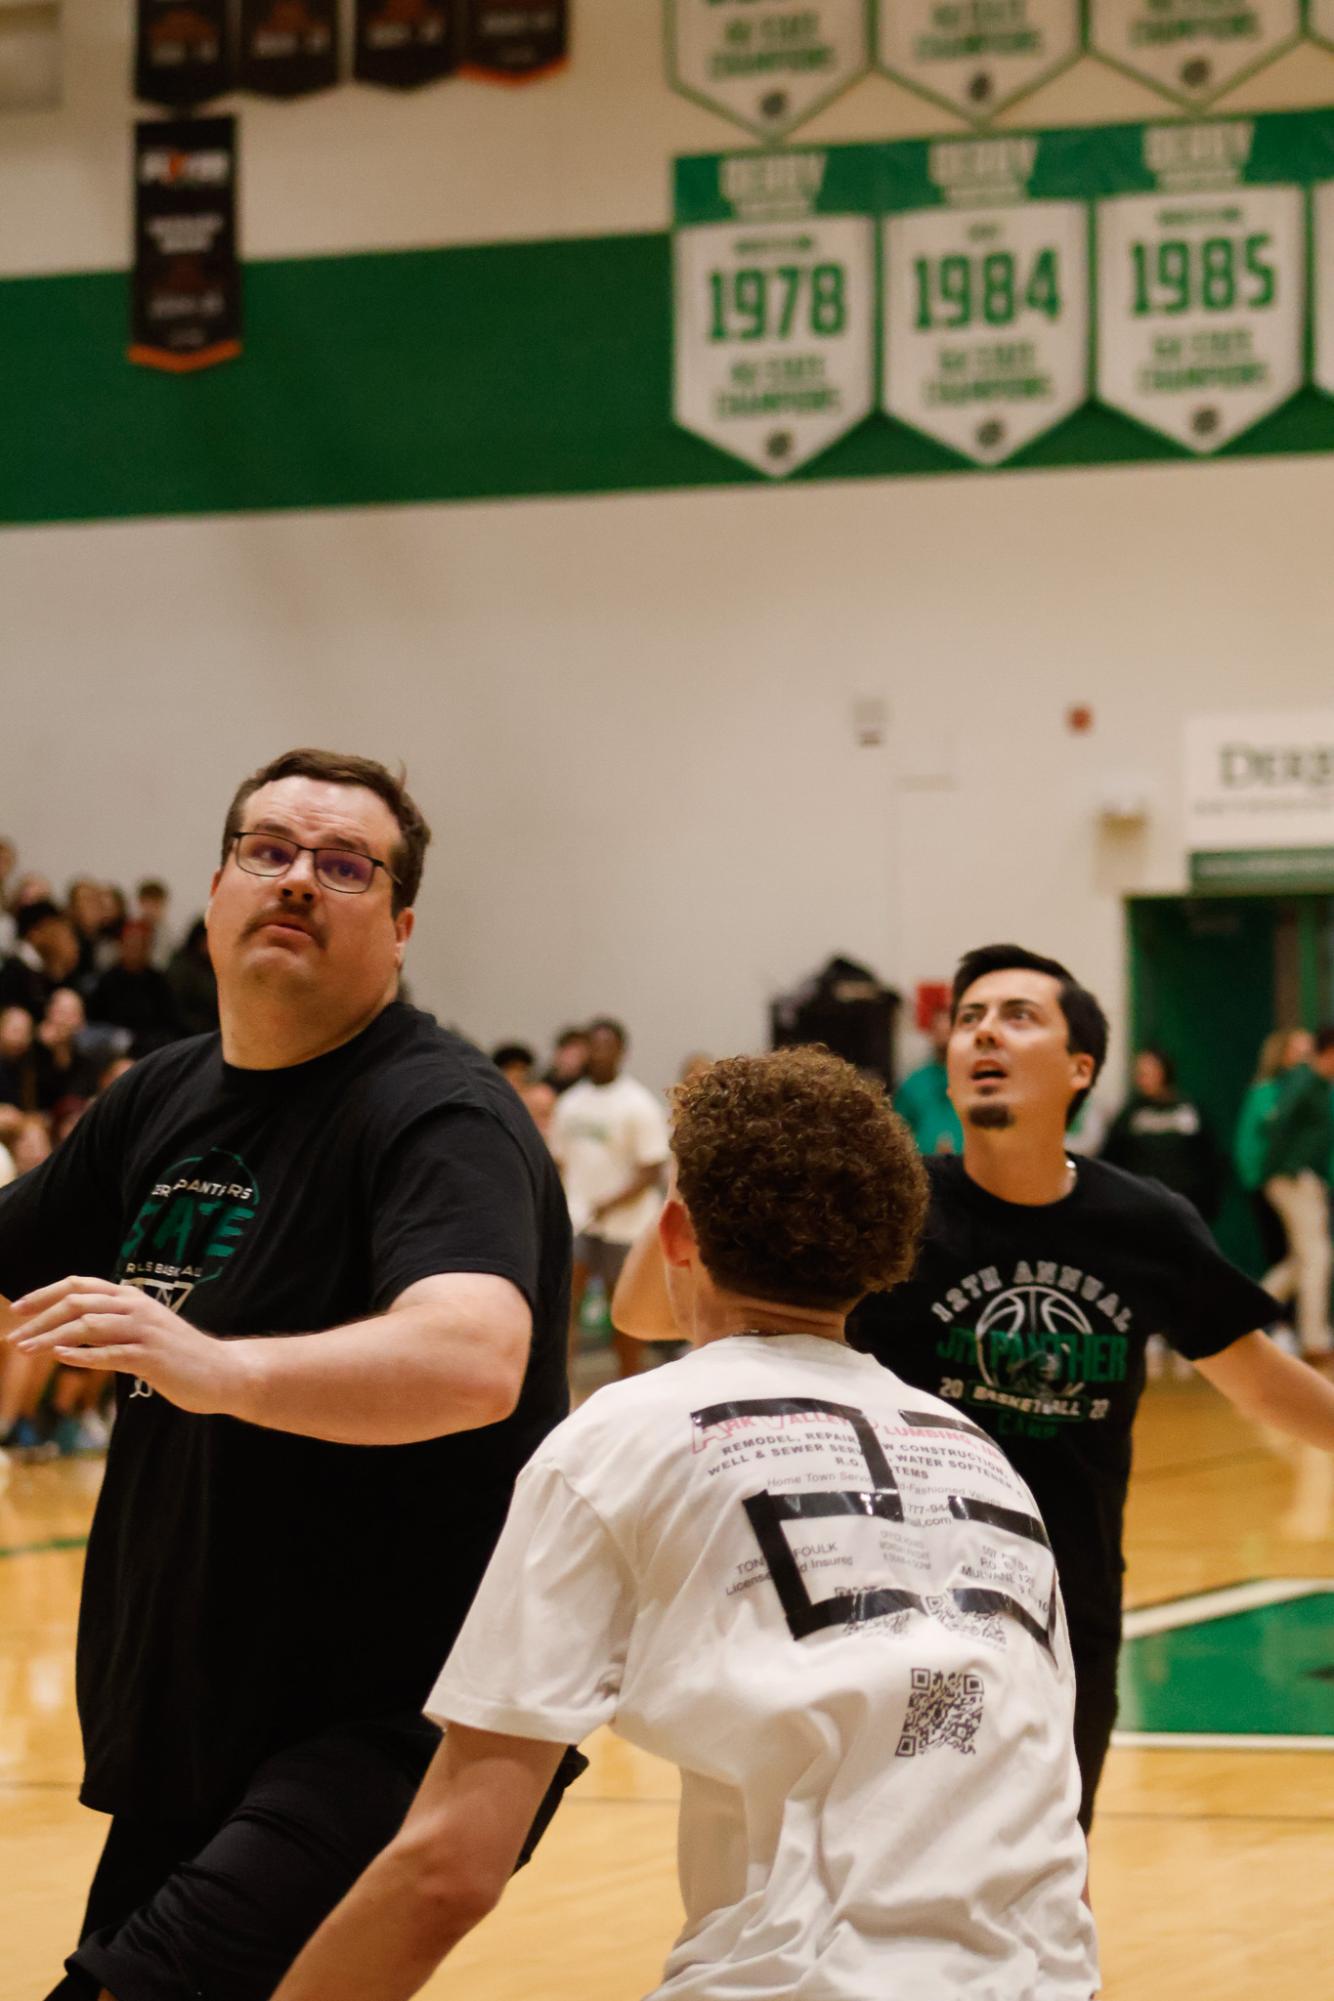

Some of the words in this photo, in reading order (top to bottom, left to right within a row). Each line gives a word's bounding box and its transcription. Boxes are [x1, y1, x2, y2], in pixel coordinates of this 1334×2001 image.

[916, 248, 1060, 329] 1984
[1131, 234, 1275, 315] 1985
[711, 263, 846, 342] 1978
[707, 1453, 749, 1477] WELL
[755, 1451, 766, 1460] &
[772, 1443, 825, 1457] SEWER
[896, 1454, 943, 1468] WATER
[894, 1465, 929, 1480] TEMS
[767, 1475, 801, 1488] Home
[807, 1471, 837, 1483] Town
[736, 1556, 766, 1575] TON
[793, 1541, 838, 1559] FOULK
